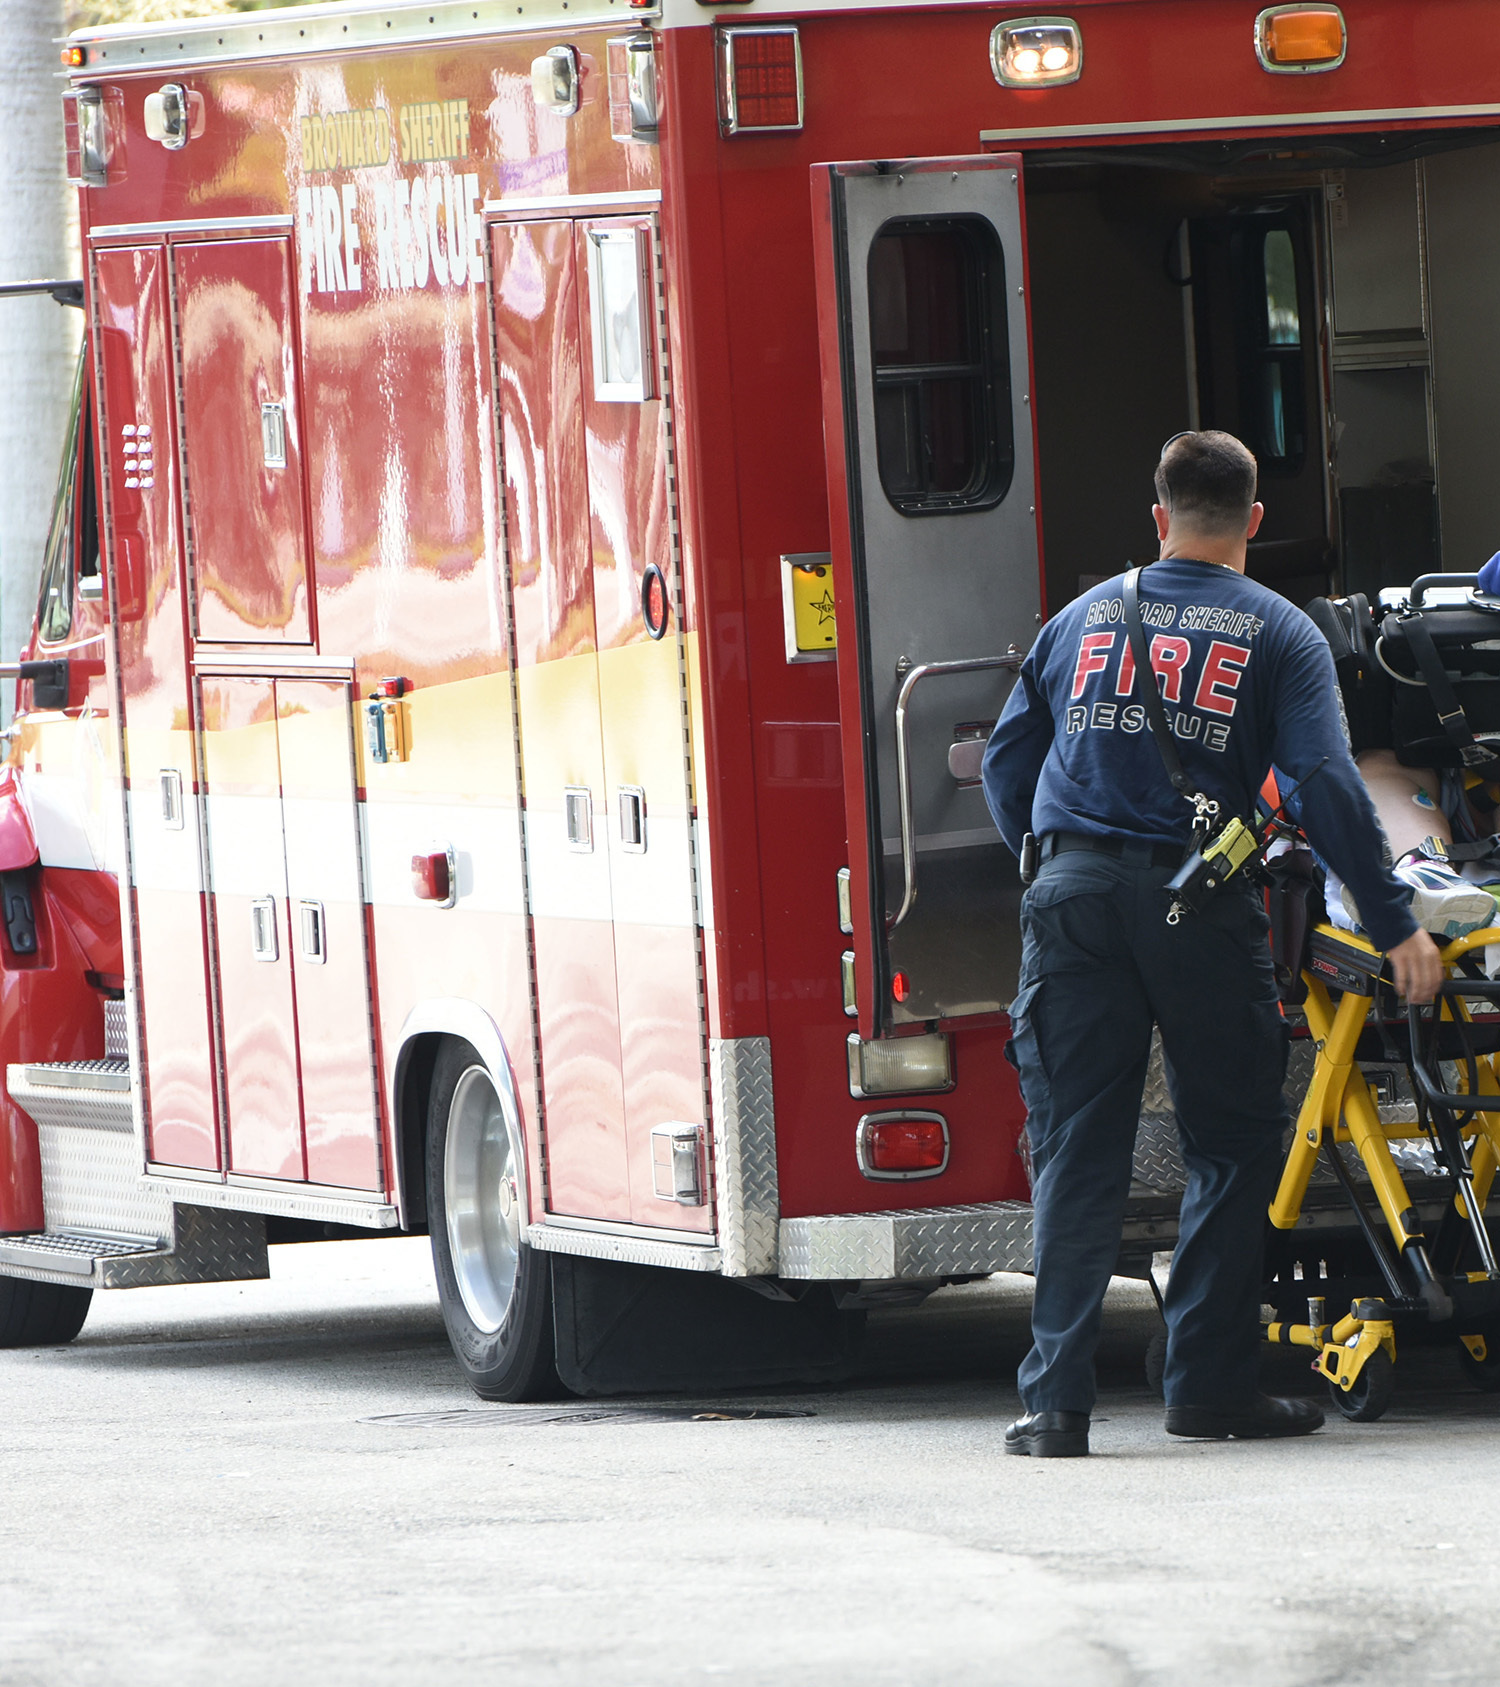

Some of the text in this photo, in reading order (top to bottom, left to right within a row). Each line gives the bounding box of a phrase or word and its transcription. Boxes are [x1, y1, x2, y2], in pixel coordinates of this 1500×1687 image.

[301, 98, 470, 173] BROWARD SHERIFF
[297, 173, 485, 293] FIRE RESCUE
[1085, 598, 1264, 640] BROARD SHERIFF
[1070, 632, 1251, 717] FIRE
